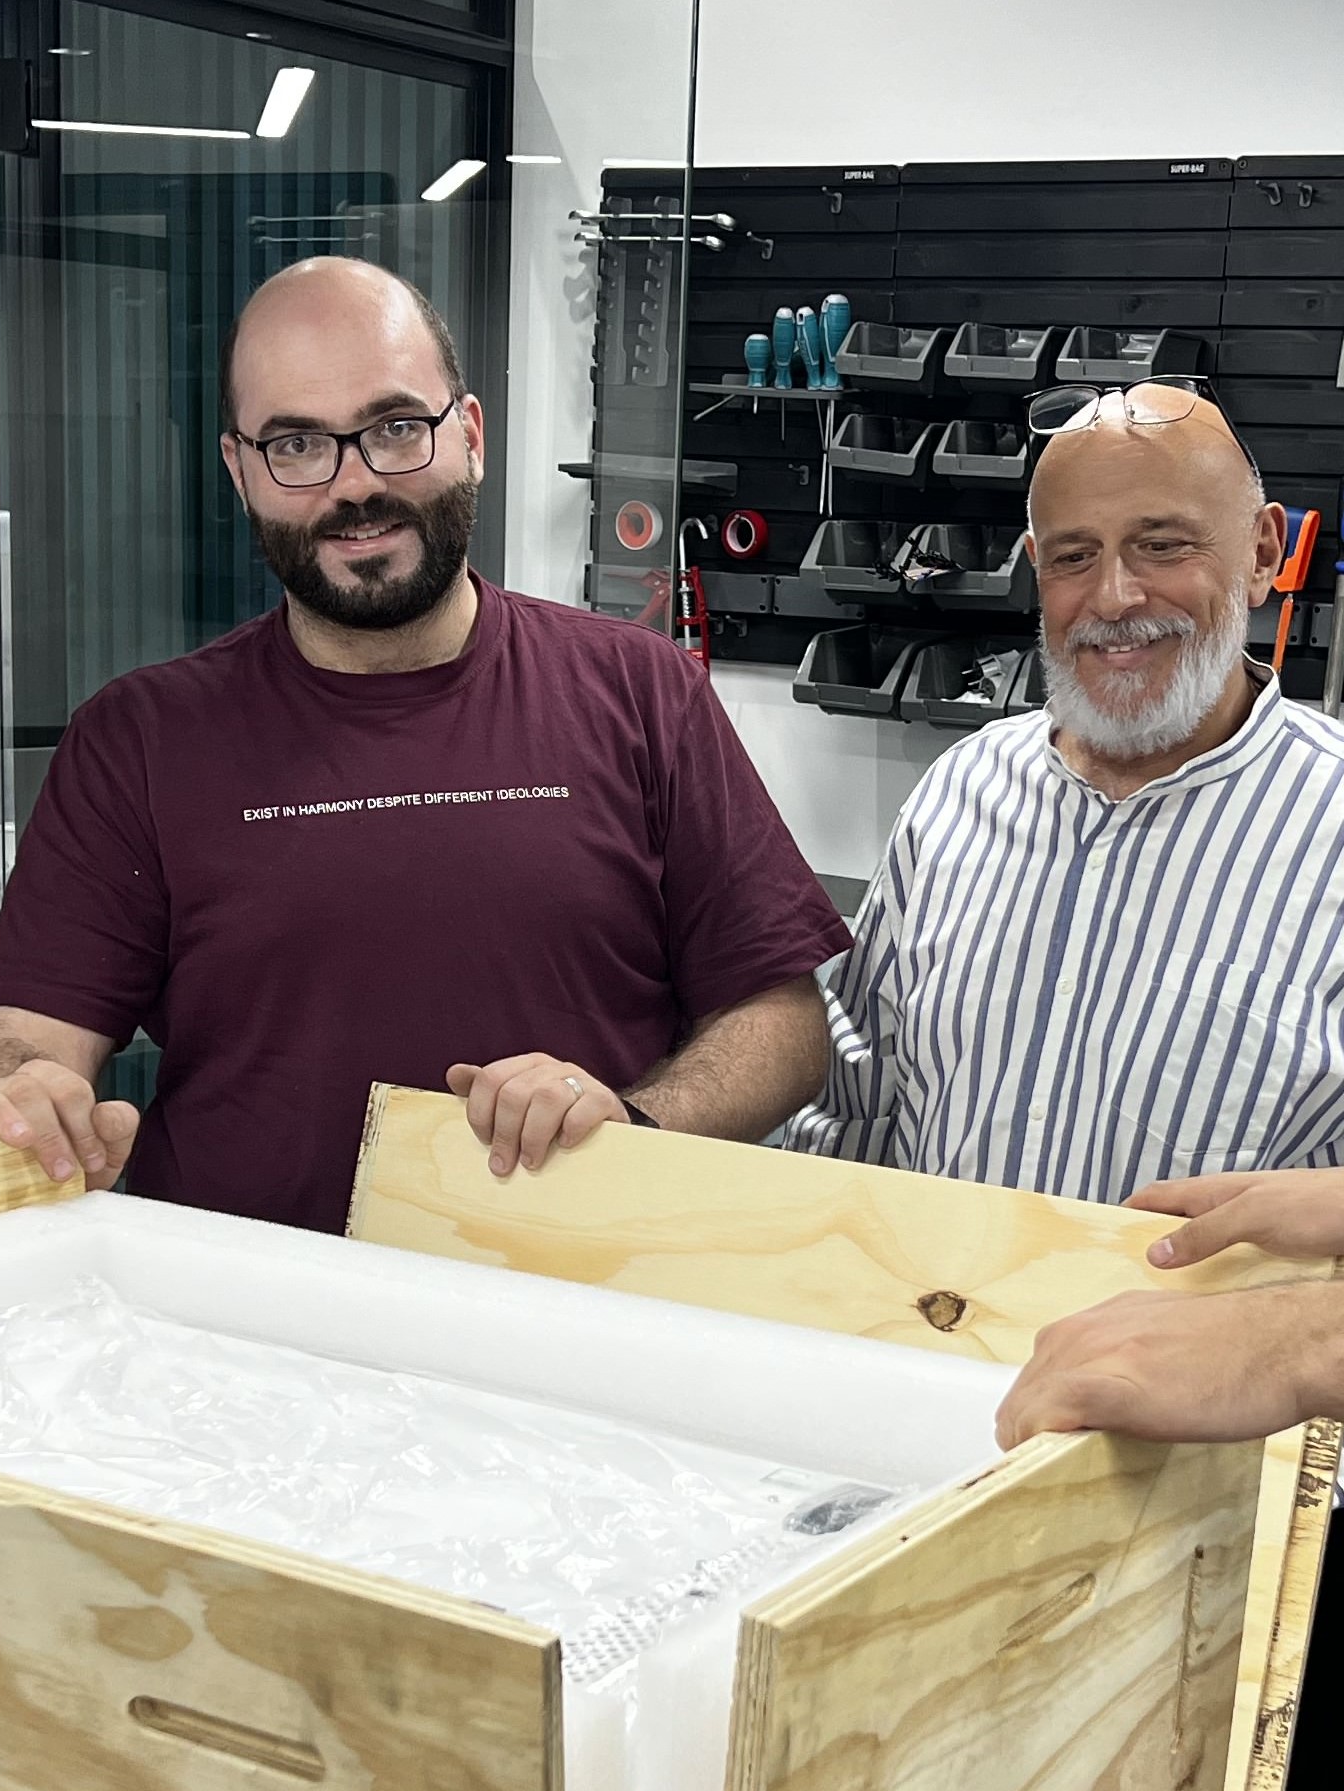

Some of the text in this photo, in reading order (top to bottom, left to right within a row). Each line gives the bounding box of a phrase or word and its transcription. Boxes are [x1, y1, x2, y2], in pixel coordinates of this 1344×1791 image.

[243, 786, 570, 821] EXIST IN HARMONY DESPITE DIFFERENT IDEOLOGIES
